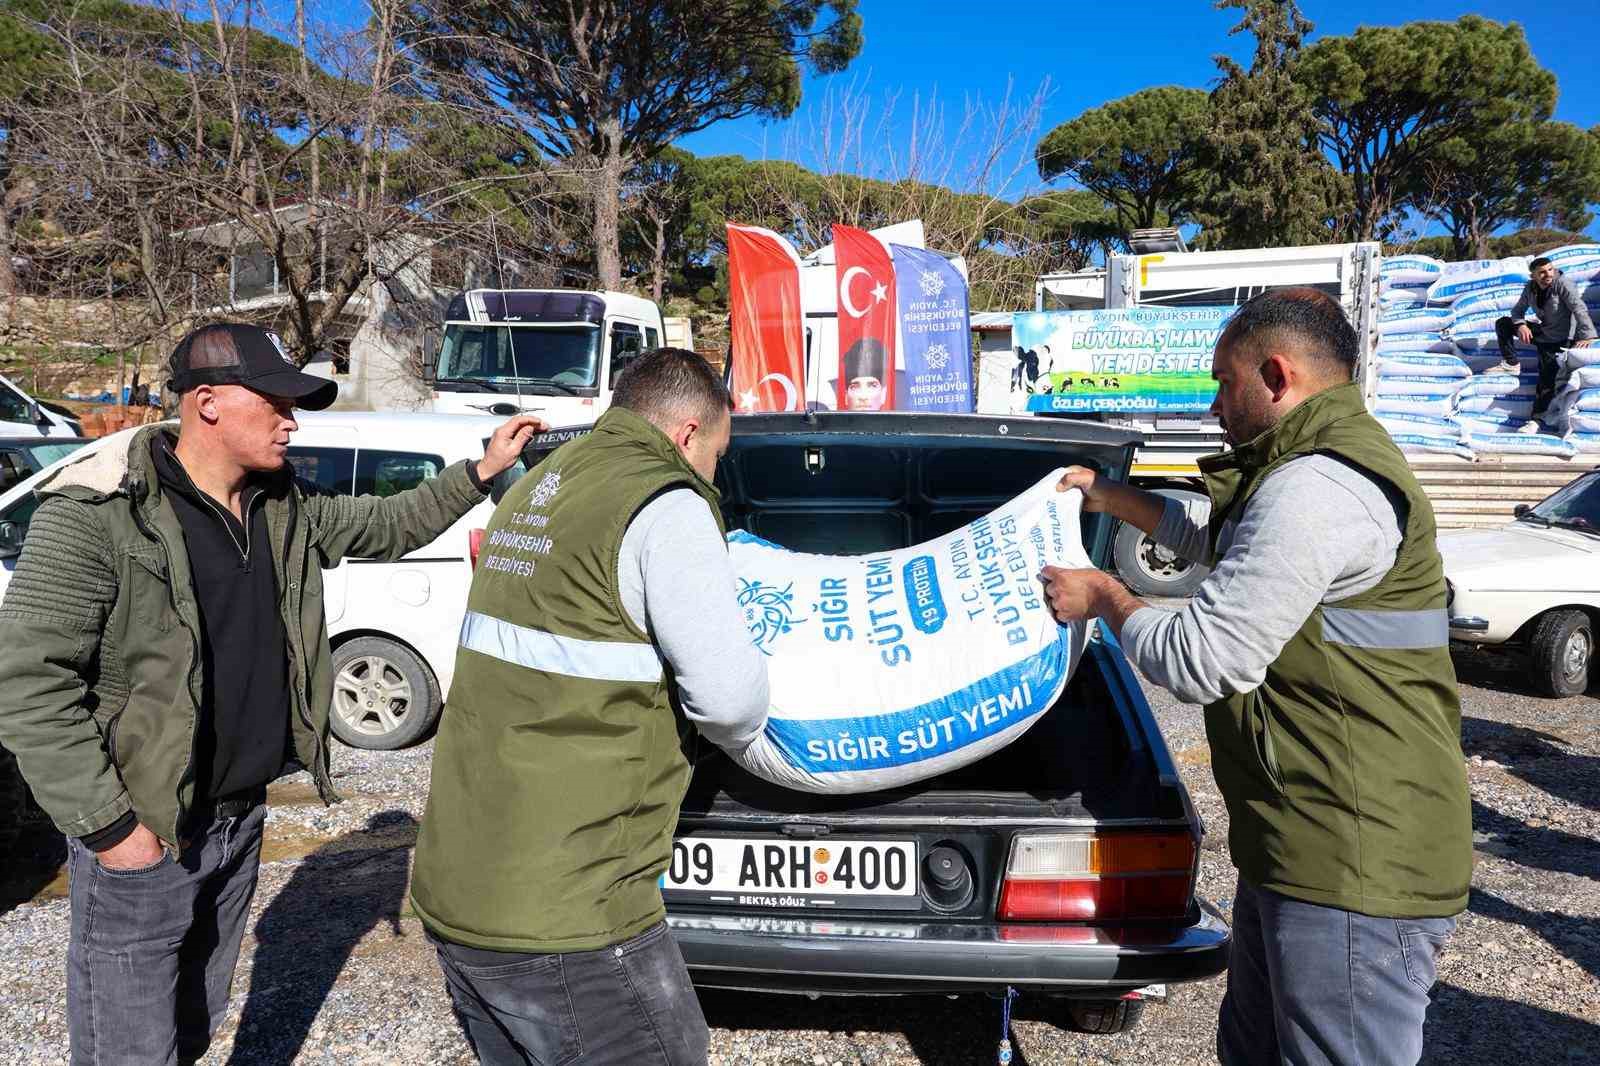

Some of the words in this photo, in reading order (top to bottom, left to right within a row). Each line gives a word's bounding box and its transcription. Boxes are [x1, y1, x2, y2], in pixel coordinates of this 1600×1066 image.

[1071, 325, 1168, 353] BÜYÜKBAŞ
[1091, 353, 1135, 375] YEM
[1052, 396, 1091, 410] ÖZLEM
[1092, 395, 1158, 412] ÇERÇİOĞLU
[525, 513, 551, 528] AYDIN
[489, 529, 554, 555] BÜYÜKŞEHİR
[485, 555, 536, 577] BELEDİYESİ
[950, 538, 972, 580] AYDIN
[859, 556, 895, 604] YEMİ
[812, 577, 854, 642] SIĞIR
[961, 583, 985, 621] T.C.
[866, 609, 912, 667] SÜT
[806, 731, 891, 763] SIĞIR
[897, 718, 956, 755] SÜT
[960, 675, 1034, 733] YEMİ
[670, 841, 714, 886] 09
[738, 844, 812, 889] ARH
[832, 846, 907, 891] 400
[739, 895, 777, 906] BEKTAŞ
[779, 896, 806, 907] OĞUZ
